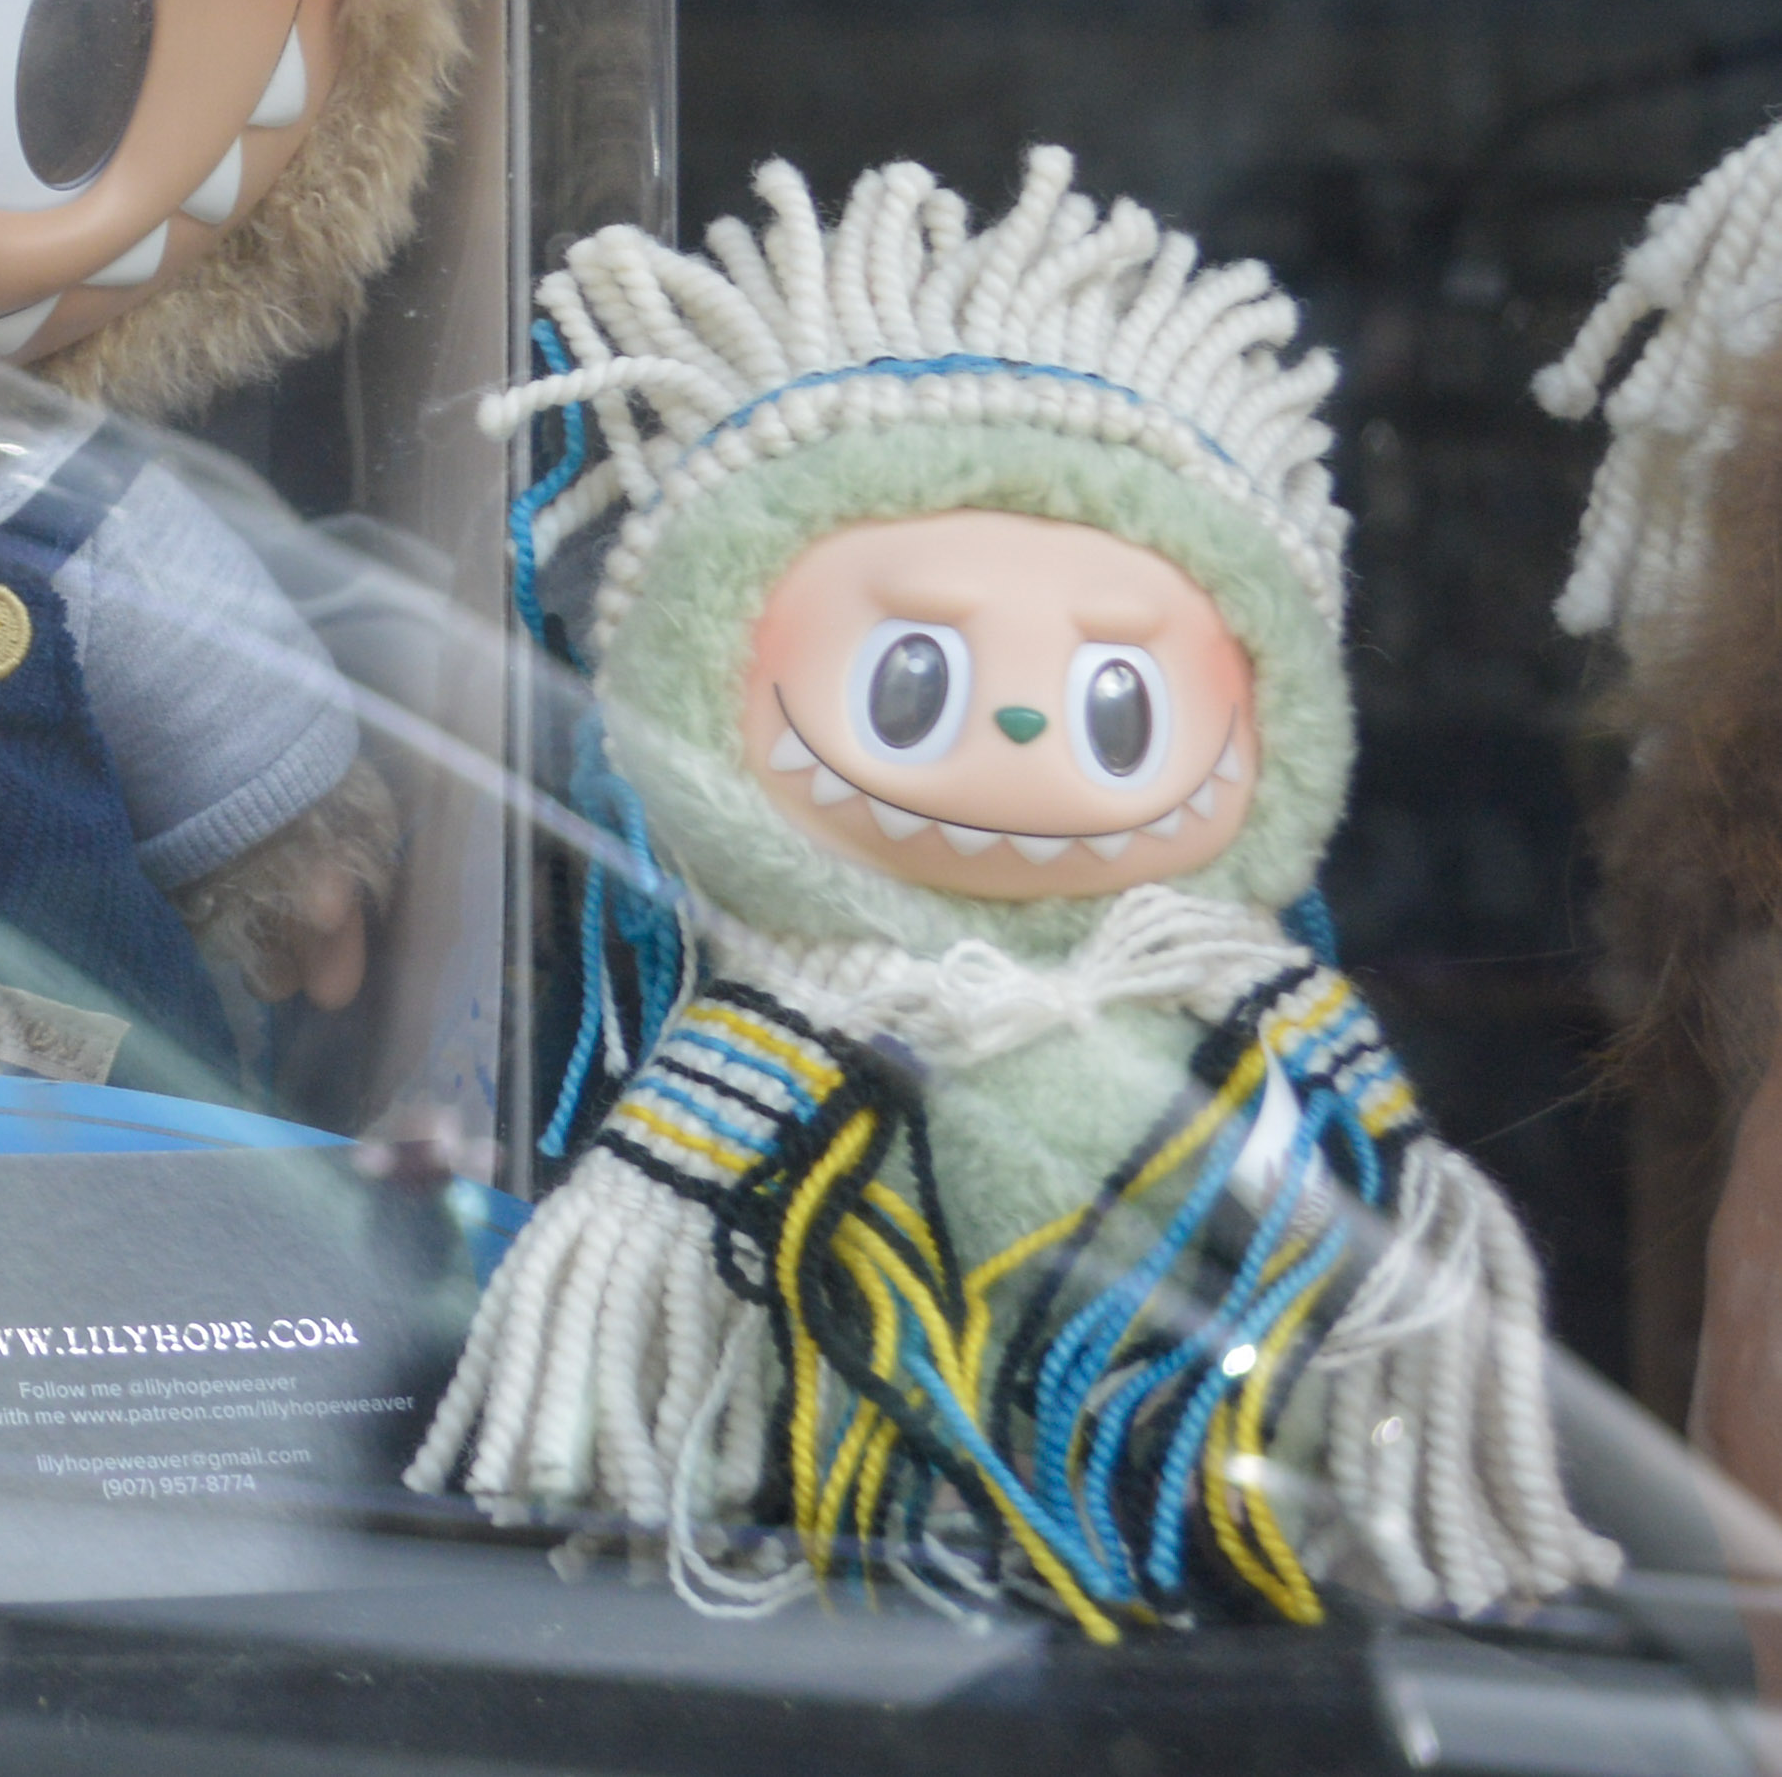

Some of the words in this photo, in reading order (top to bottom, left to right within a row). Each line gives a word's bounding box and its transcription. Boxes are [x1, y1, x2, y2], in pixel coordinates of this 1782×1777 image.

[18, 1380, 85, 1400] Follow
[91, 1382, 122, 1398] me
[129, 1376, 298, 1400] @lilyhopeweaver
[35, 1408, 66, 1425] me
[70, 1395, 415, 1426] www.patreon.com/lilyhopeweaver
[36, 1447, 312, 1476] lilyhopeweaver@gmail.com
[102, 1477, 156, 1500] (907)
[159, 1474, 256, 1496] 957-8774
